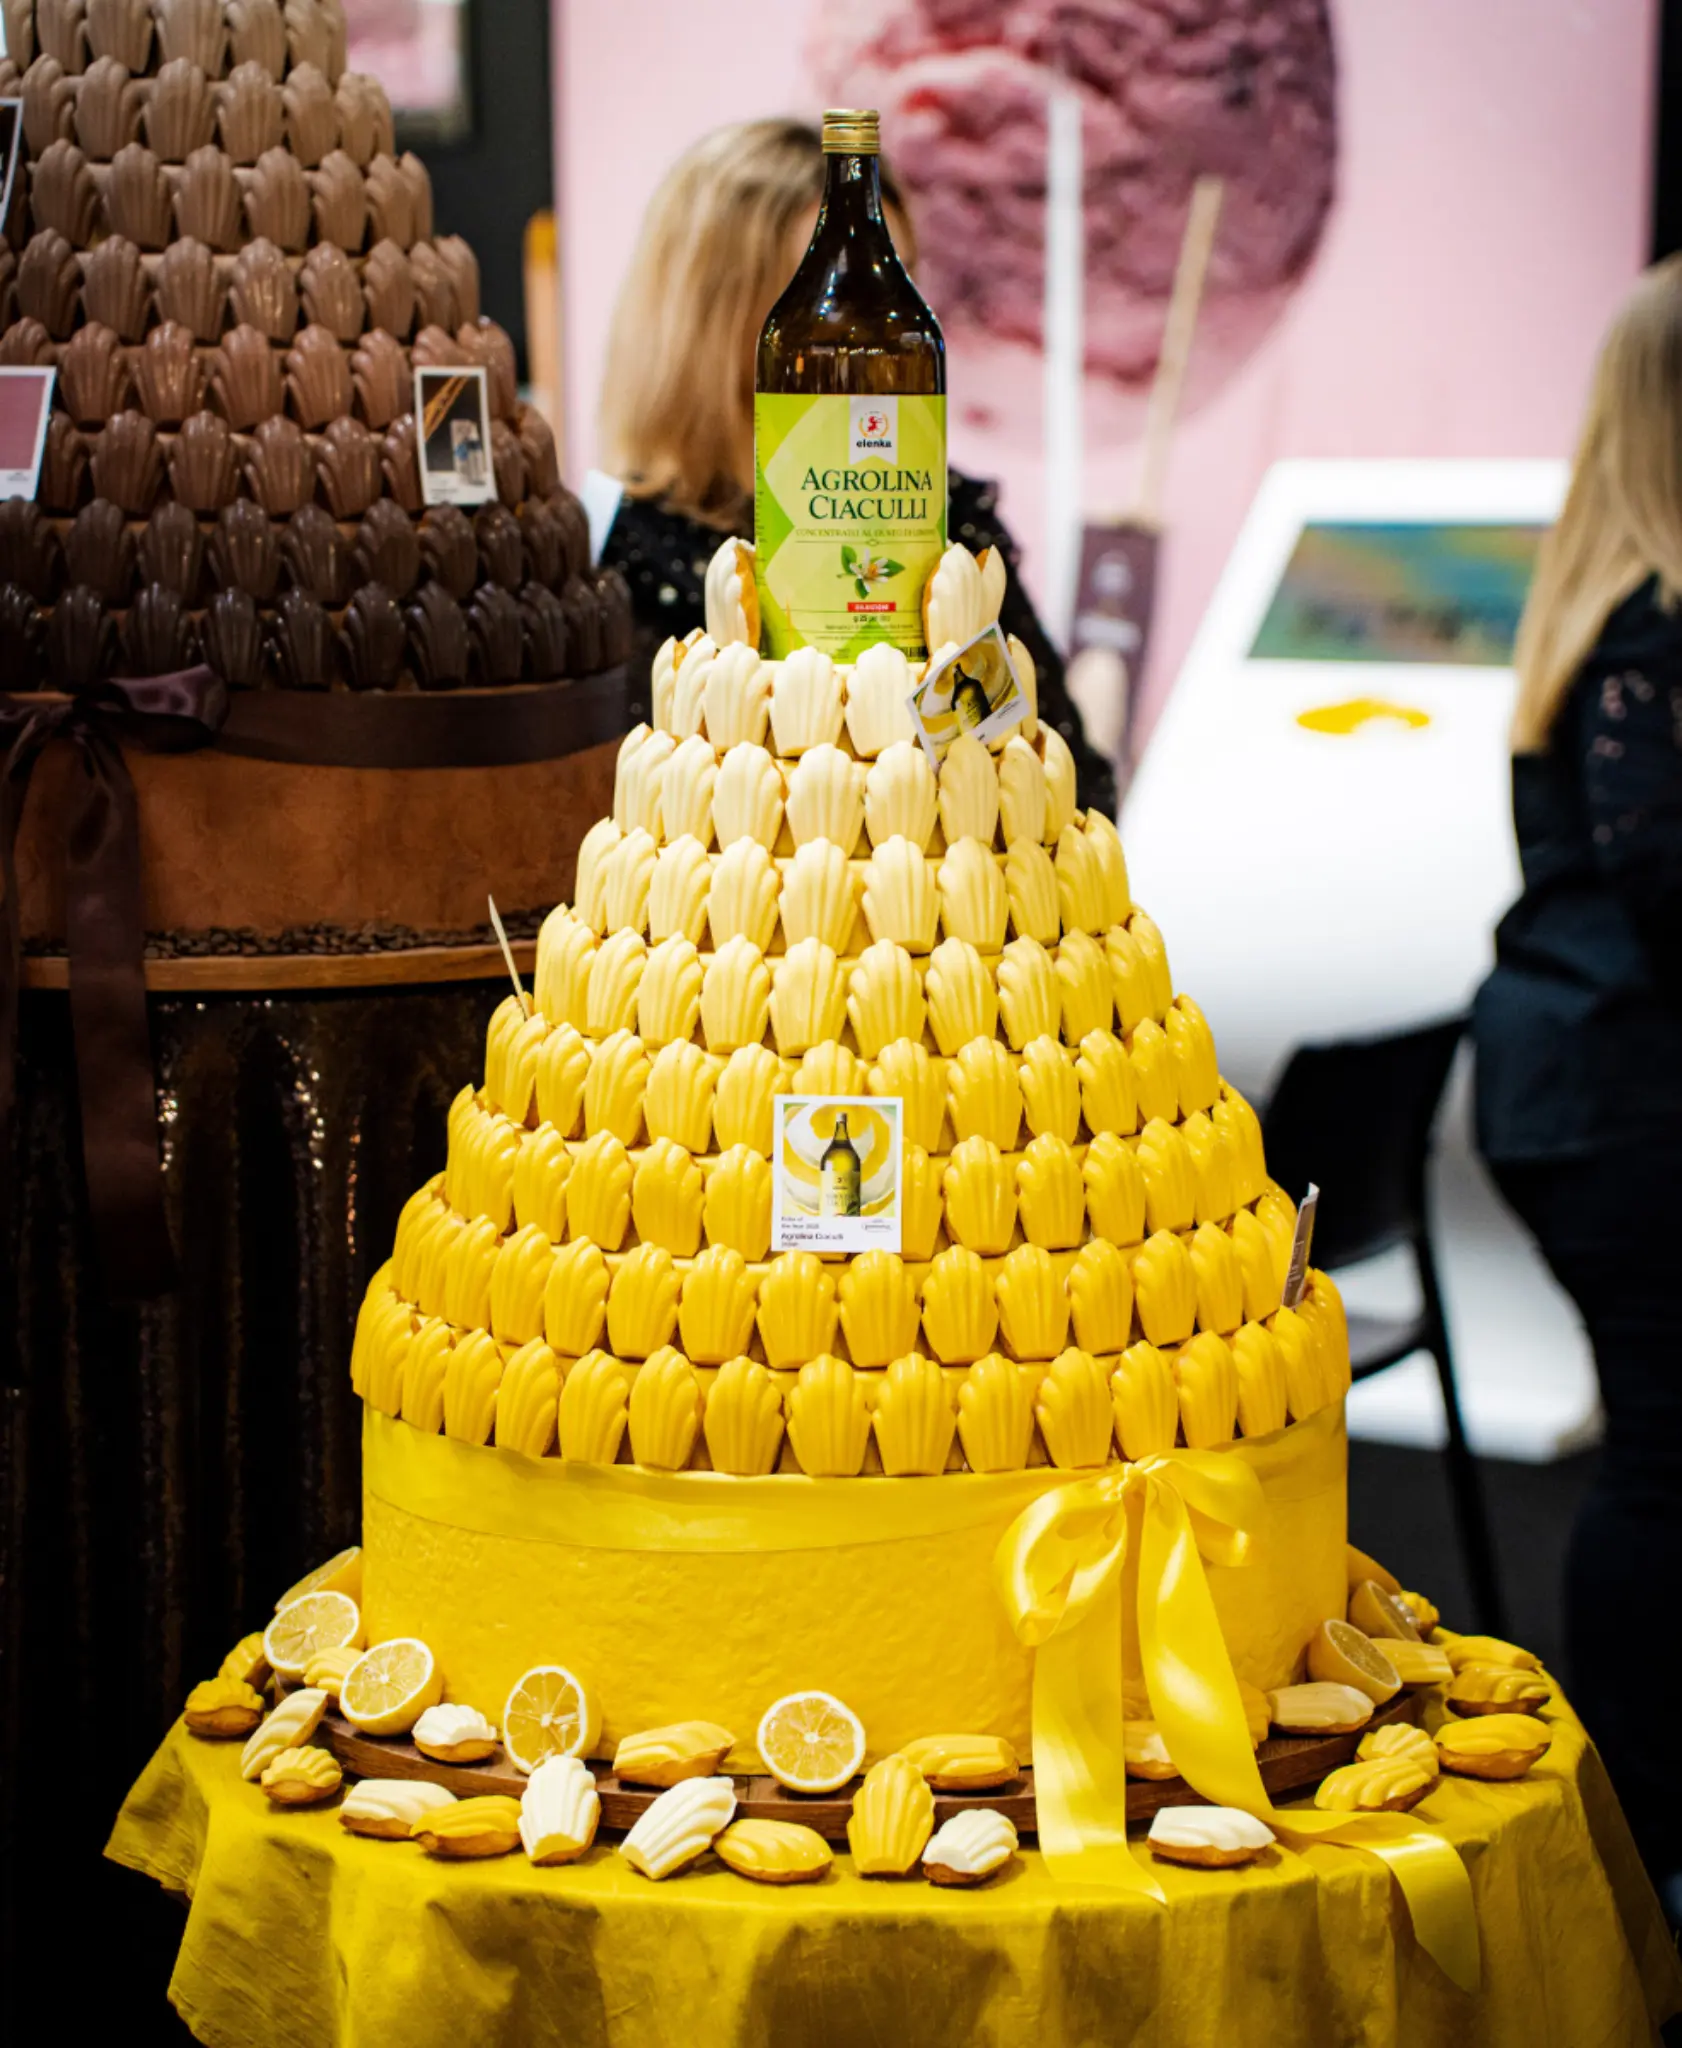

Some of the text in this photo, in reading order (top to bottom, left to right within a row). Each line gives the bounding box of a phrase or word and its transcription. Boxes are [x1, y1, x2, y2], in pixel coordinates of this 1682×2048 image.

[856, 439, 892, 449] elenka
[800, 466, 933, 492] AGROLINA
[808, 494, 928, 519] CIACULLI
